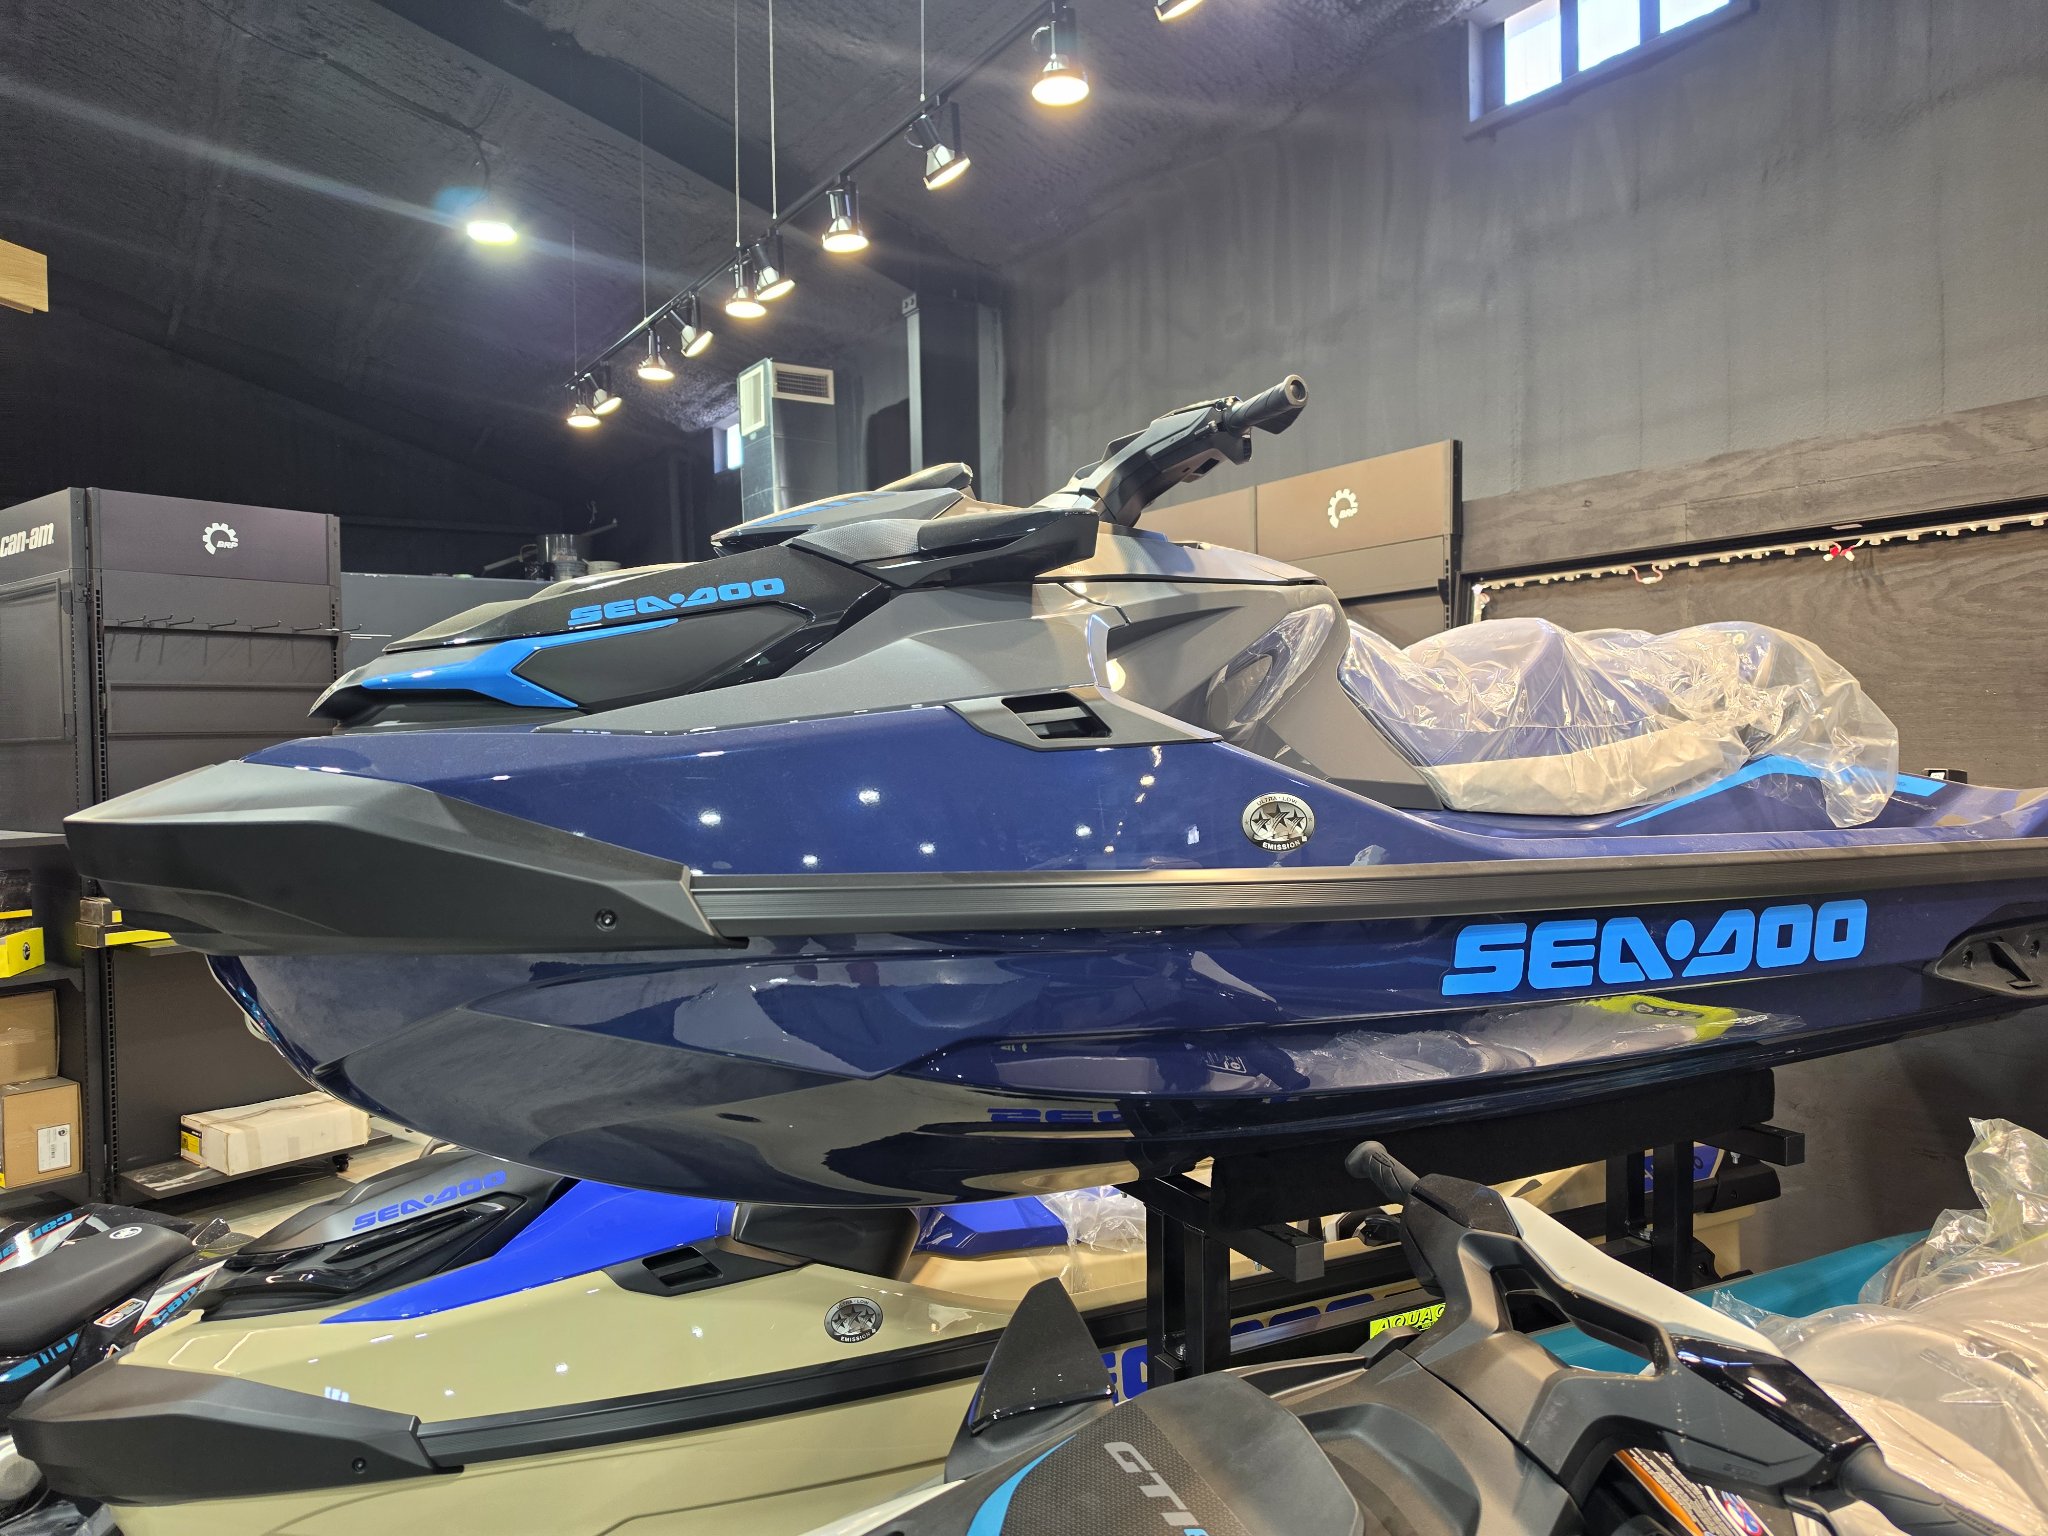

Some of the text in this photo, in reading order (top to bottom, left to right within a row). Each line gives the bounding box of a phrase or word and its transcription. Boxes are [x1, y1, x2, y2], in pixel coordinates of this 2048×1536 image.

[0, 525, 54, 557] can-am
[216, 540, 239, 549] BRP
[1262, 839, 1301, 851] EMISSION
[840, 1331, 871, 1343] EMISSION
